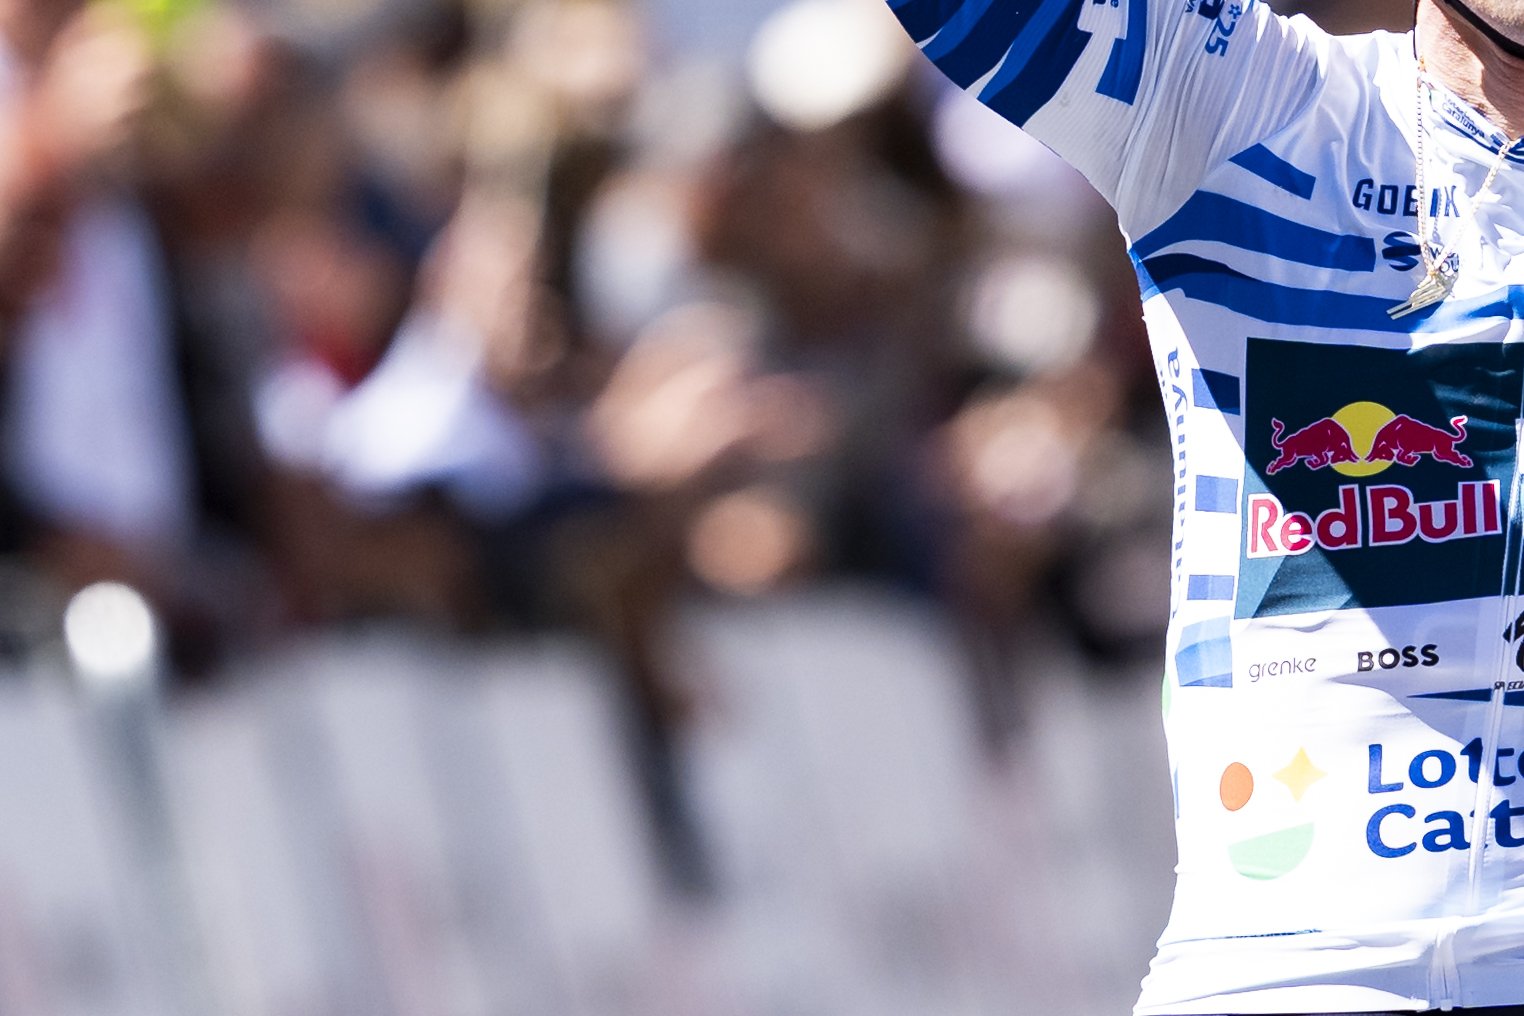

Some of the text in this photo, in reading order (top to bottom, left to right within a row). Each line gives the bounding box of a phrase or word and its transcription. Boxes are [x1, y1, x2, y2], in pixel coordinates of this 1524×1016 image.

[1249, 480, 1501, 557] Red Bull
[1248, 657, 1316, 683] grenke
[1357, 644, 1439, 672] BOSS
